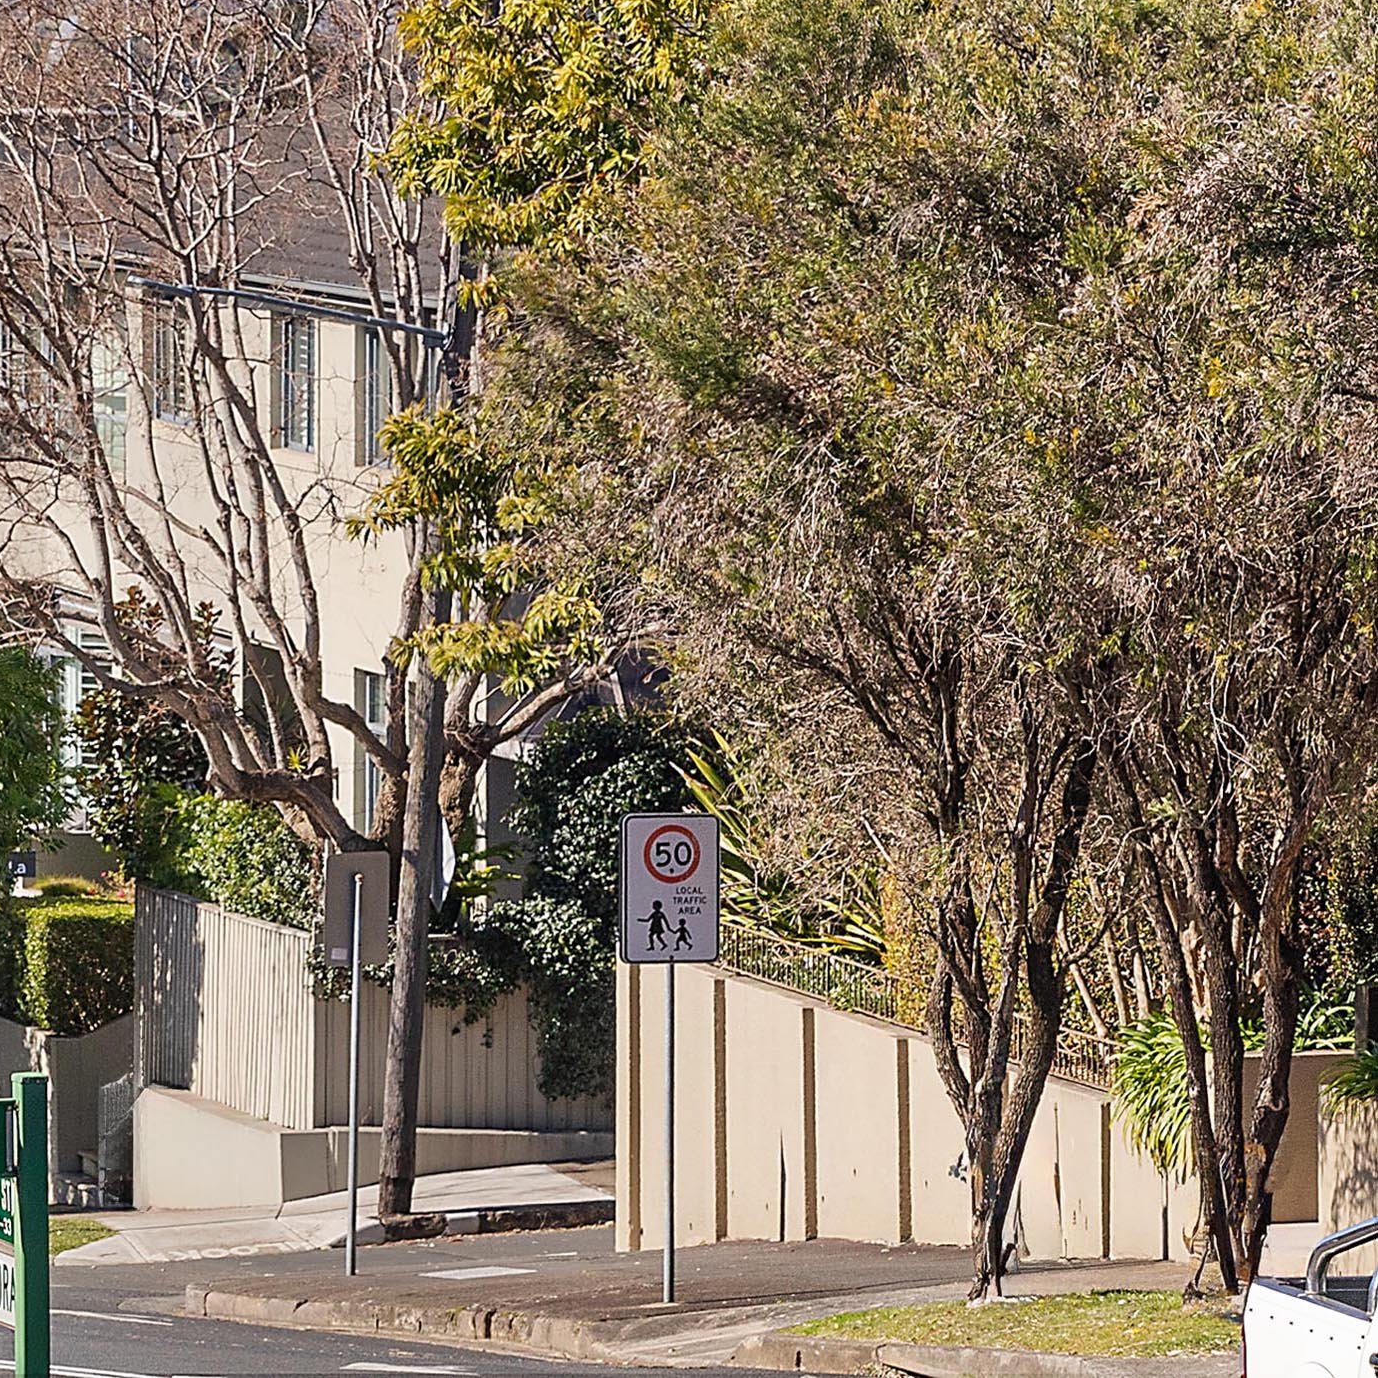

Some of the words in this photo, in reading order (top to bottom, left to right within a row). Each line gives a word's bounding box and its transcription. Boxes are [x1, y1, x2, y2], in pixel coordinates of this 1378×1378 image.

[656, 841, 692, 868] 50
[676, 886, 703, 895] LOCAL
[673, 896, 707, 905] TRAFFIC
[677, 906, 702, 915] AREA
